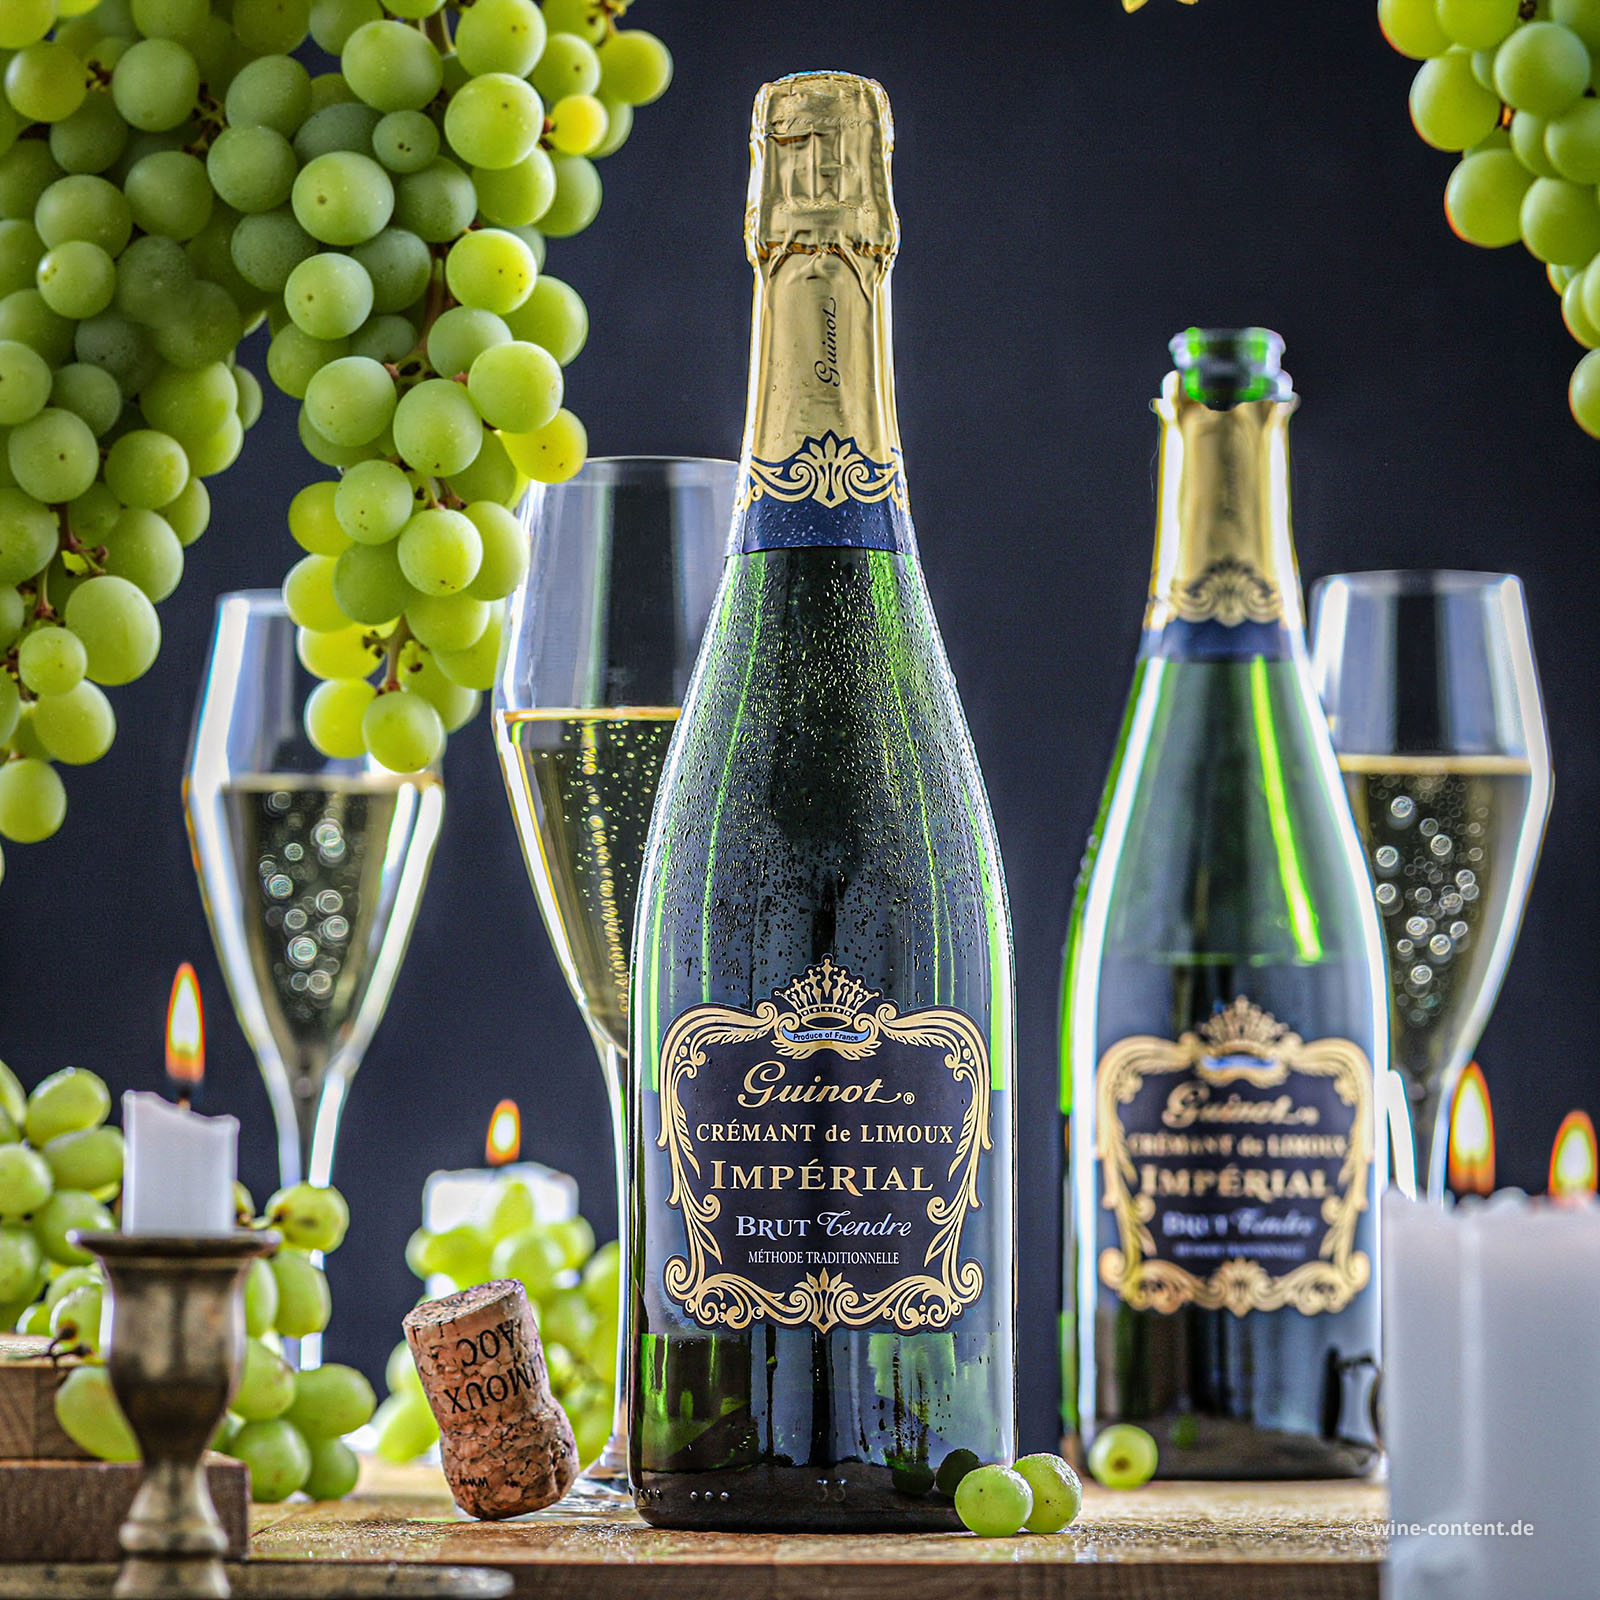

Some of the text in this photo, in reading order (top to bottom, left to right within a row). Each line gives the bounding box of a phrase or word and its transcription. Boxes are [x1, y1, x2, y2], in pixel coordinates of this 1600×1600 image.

[814, 297, 840, 387] Guinot
[792, 1031, 860, 1042] Produce of France
[696, 1119, 954, 1144] CRÉMANT de LIMOUX
[710, 1158, 934, 1197] IMPÉRIAL
[1140, 1163, 1335, 1203] IMPÉRIAL
[736, 1211, 912, 1240] BRUT Tendre
[748, 1248, 900, 1265] MÉTHODE TRADITIONNELLE
[455, 1318, 515, 1367] AOC
